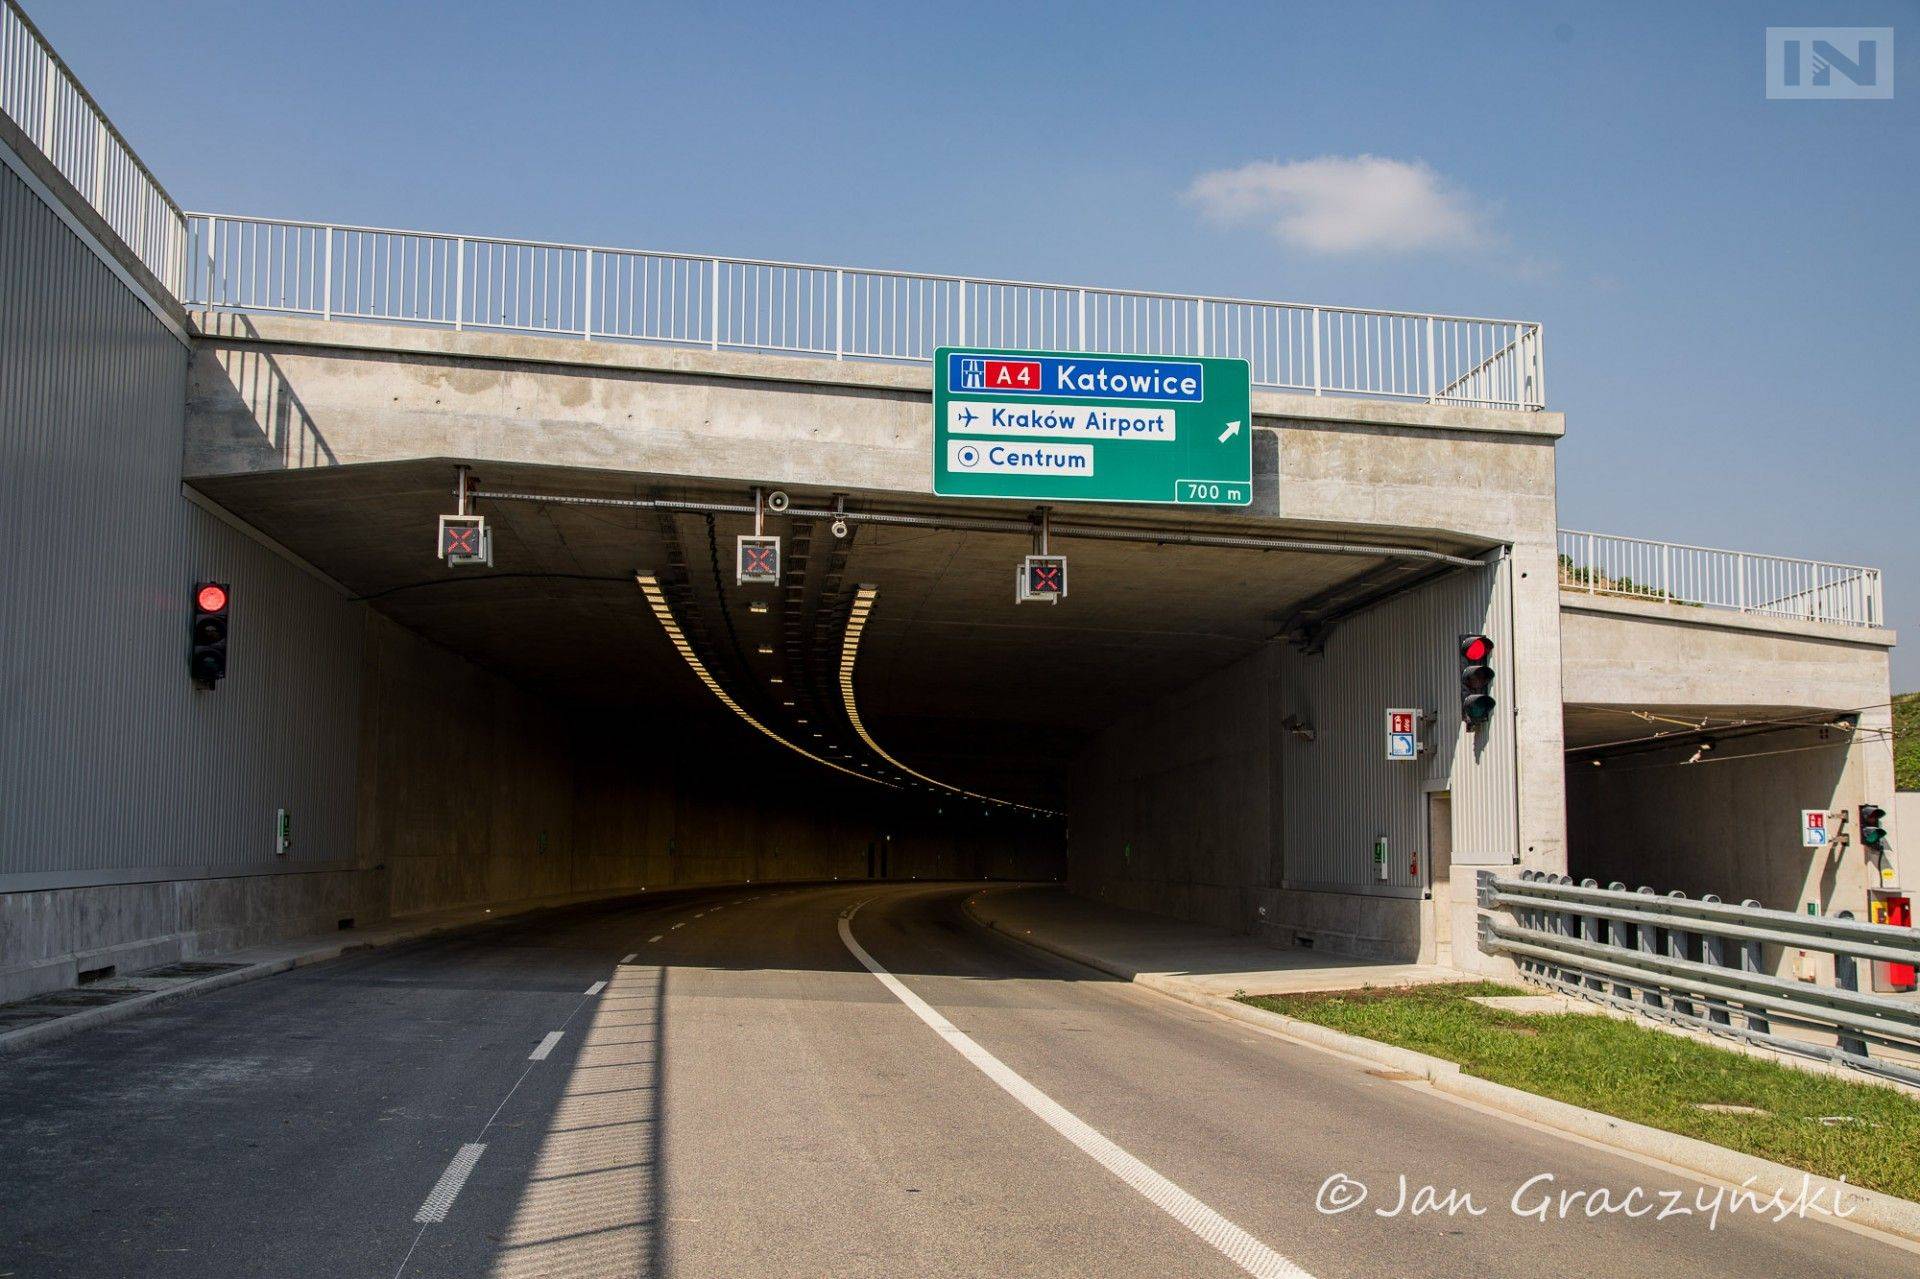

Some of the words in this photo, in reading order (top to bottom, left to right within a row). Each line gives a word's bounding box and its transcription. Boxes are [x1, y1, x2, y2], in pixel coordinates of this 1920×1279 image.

[1057, 364, 1198, 395] Katowice
[991, 407, 1075, 430] Kraków
[1085, 411, 1165, 437] Airport
[988, 446, 1087, 469] Centrum
[1188, 484, 1219, 500] 700
[1227, 489, 1241, 501] m
